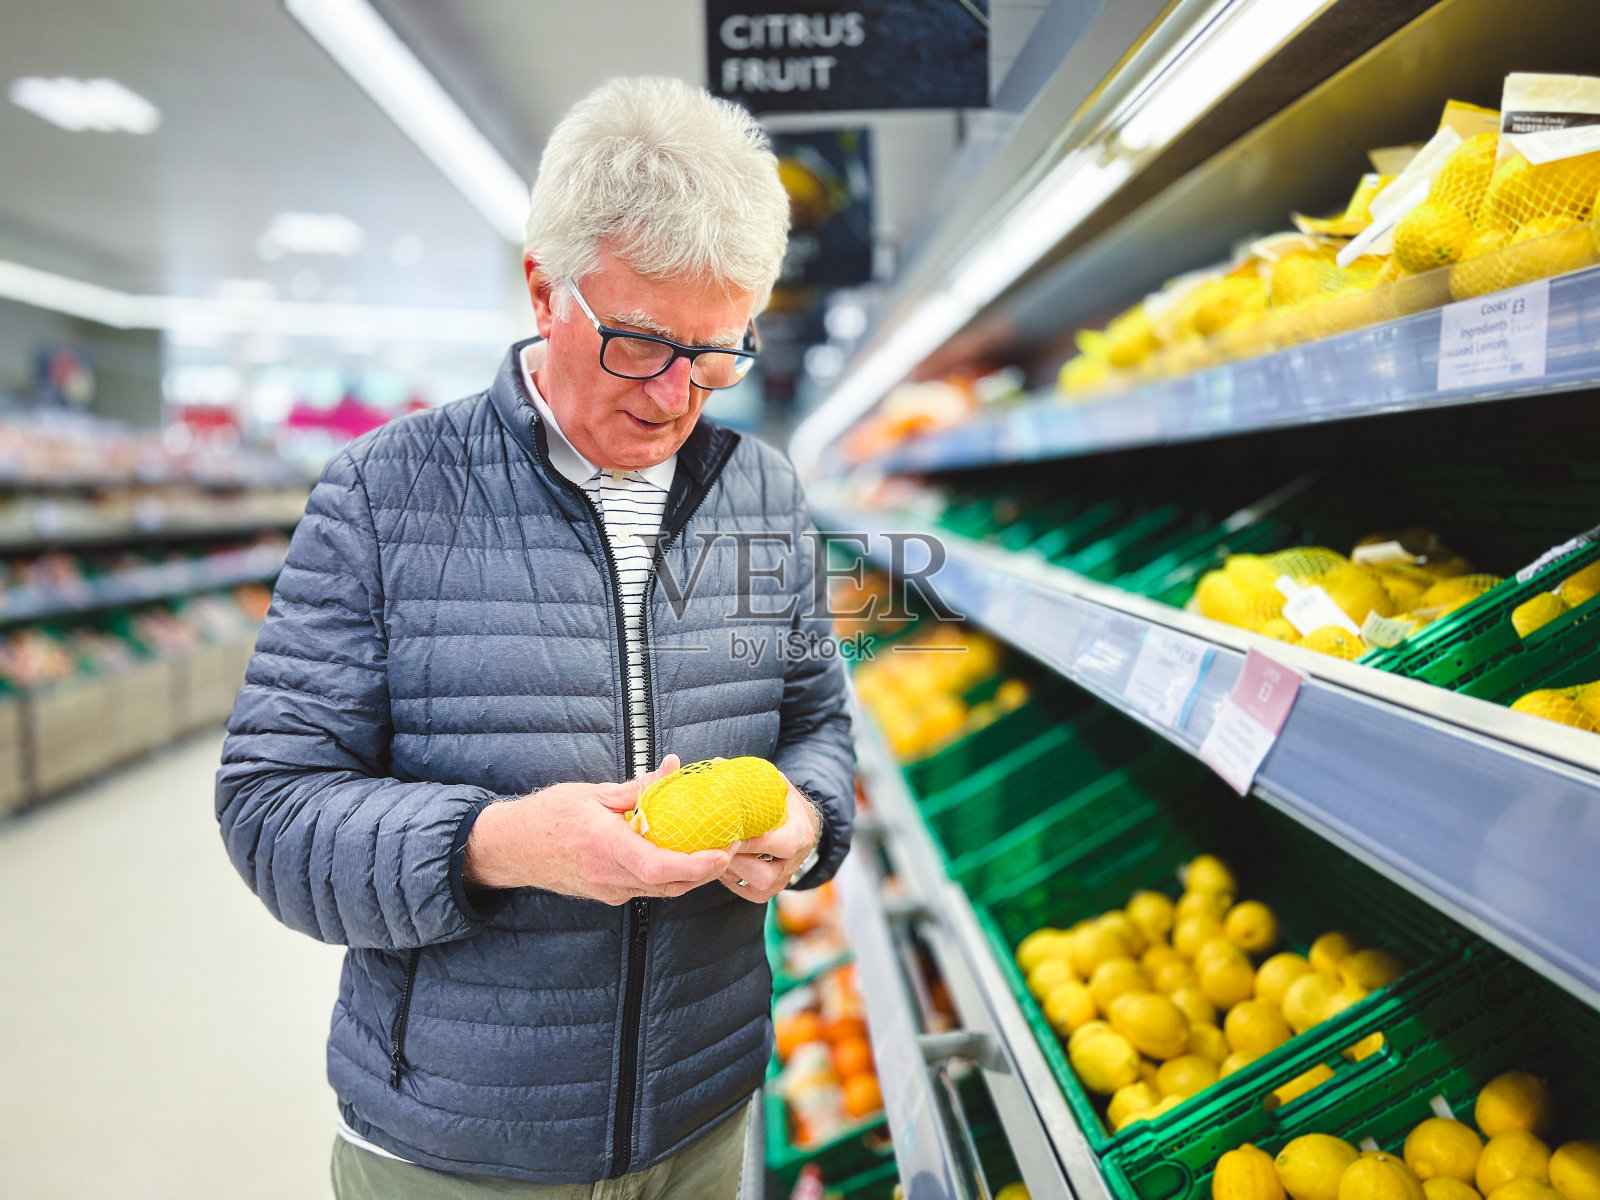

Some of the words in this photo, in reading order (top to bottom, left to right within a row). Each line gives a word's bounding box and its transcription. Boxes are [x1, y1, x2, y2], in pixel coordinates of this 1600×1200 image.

[720, 12, 865, 50] CITRUS
[722, 56, 837, 93] FRUIT
[1512, 298, 1525, 315] £3
